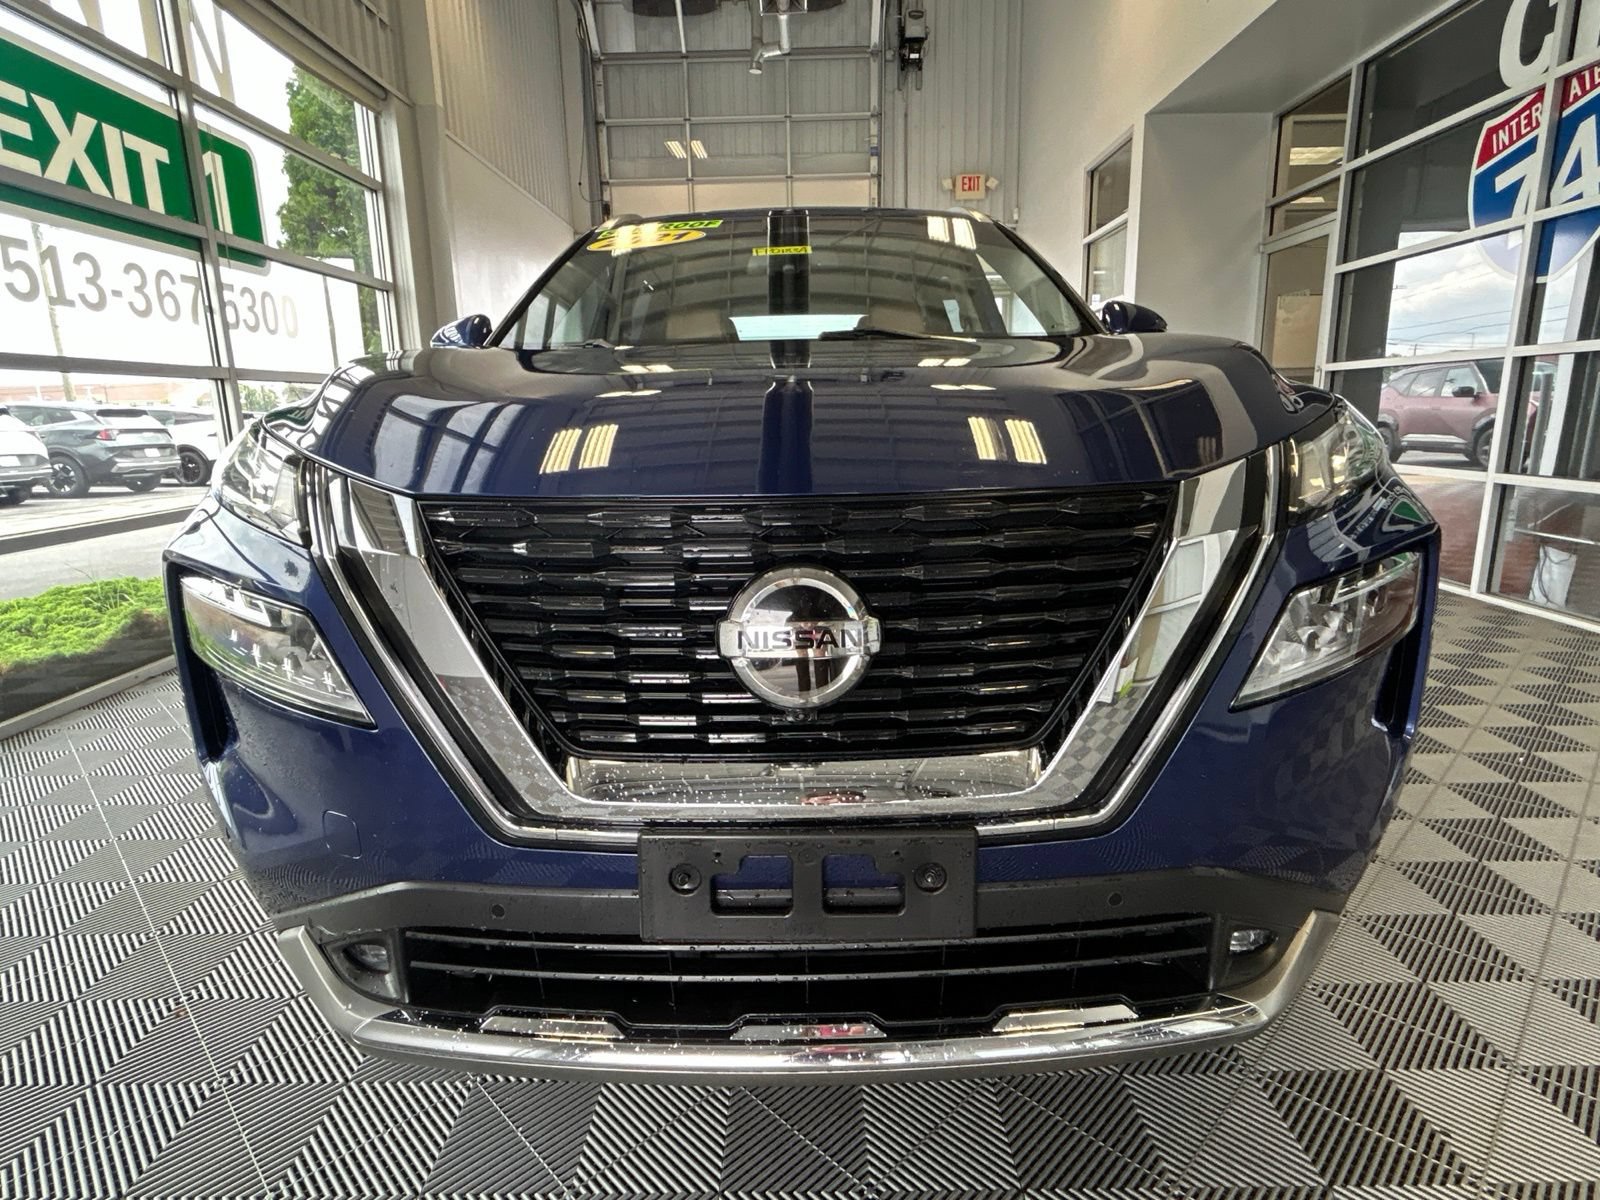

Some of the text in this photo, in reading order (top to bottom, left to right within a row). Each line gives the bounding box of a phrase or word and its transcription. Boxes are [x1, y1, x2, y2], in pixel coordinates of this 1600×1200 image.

[0, 81, 233, 235] EXIT 1
[961, 175, 981, 192] EXIT
[737, 629, 863, 650] NISSAN
